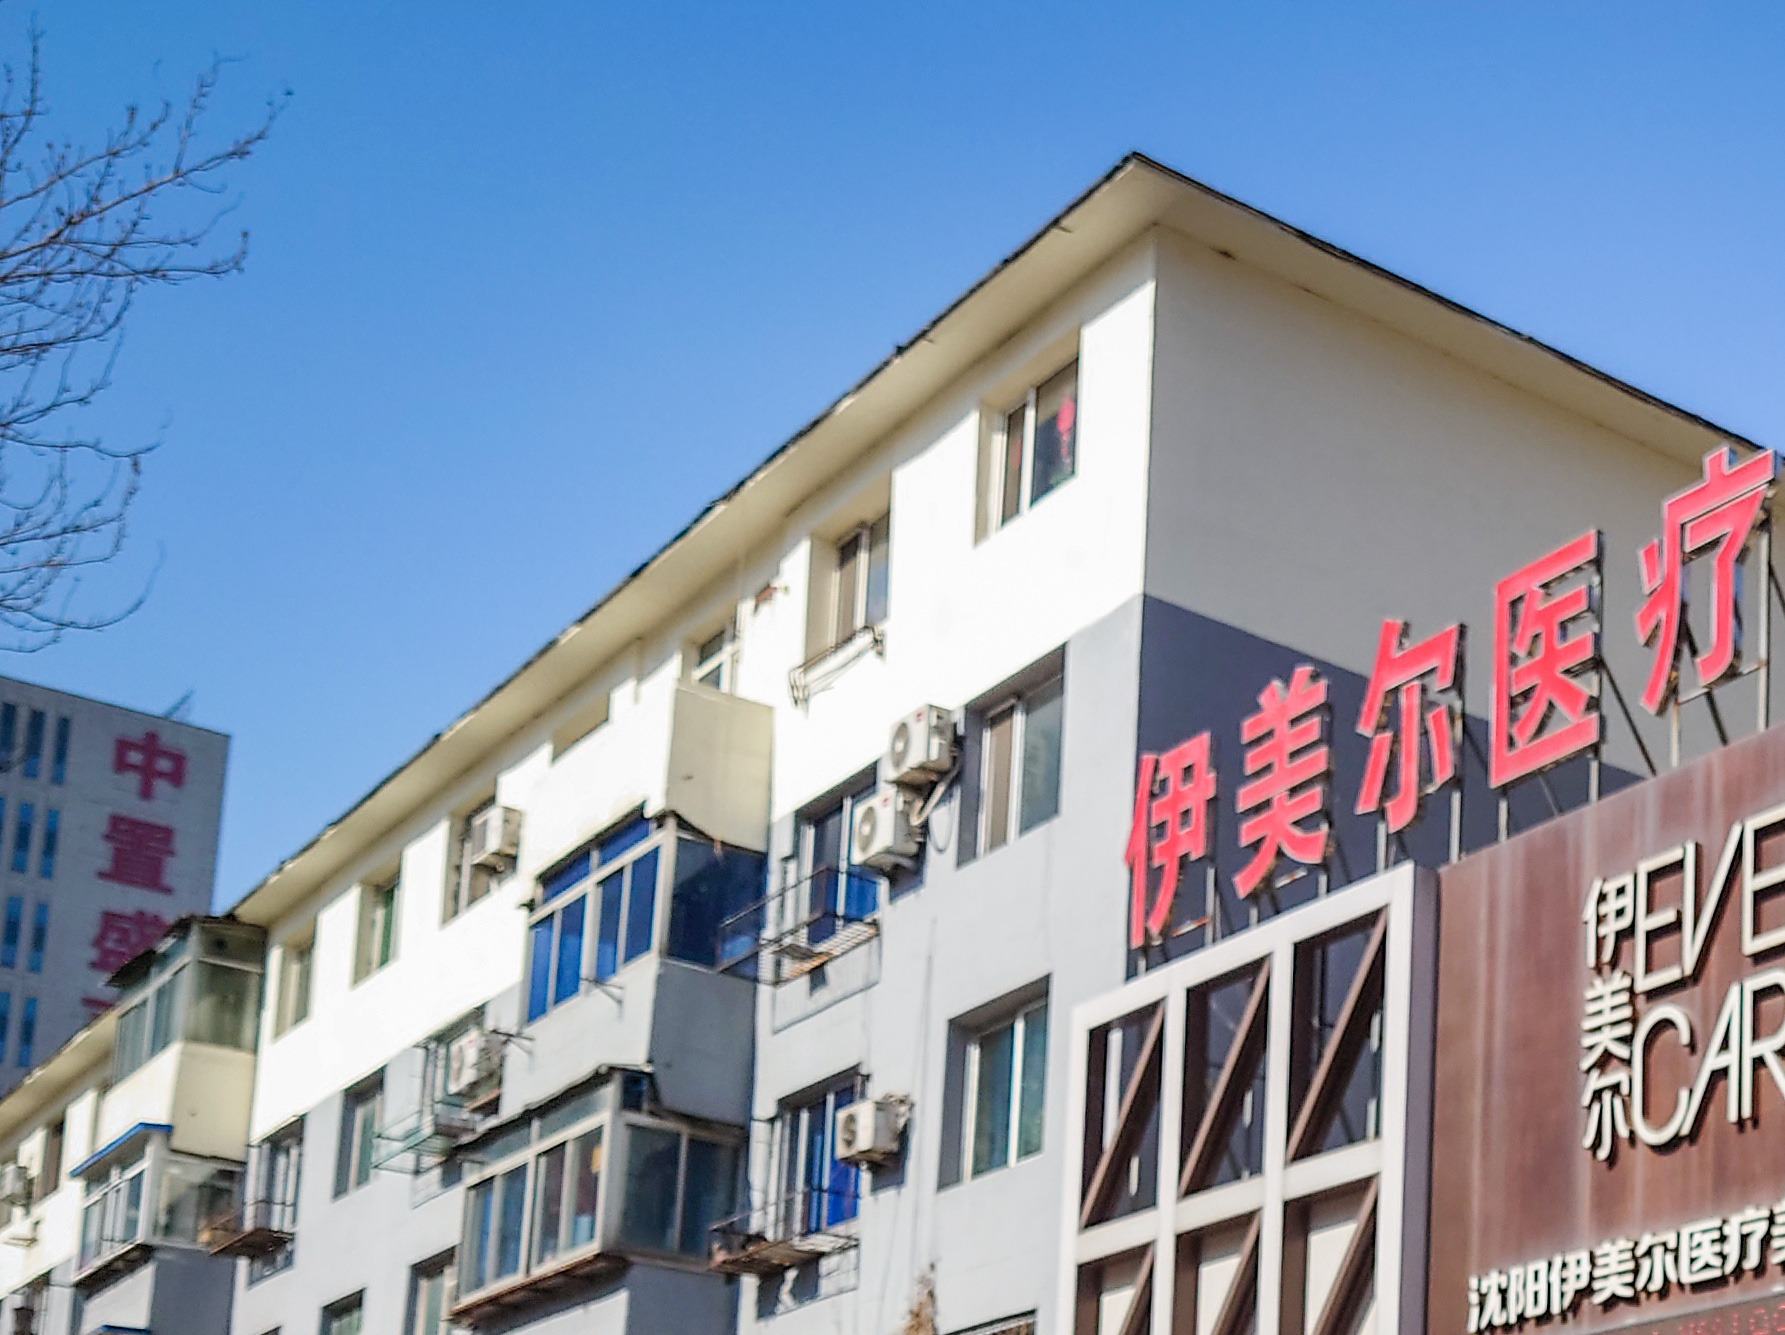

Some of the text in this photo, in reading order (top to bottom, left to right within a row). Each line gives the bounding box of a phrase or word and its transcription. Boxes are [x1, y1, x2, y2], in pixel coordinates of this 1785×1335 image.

[81, 731, 187, 1021] 中置盛
[1581, 876, 1635, 1161] 伊美尔
